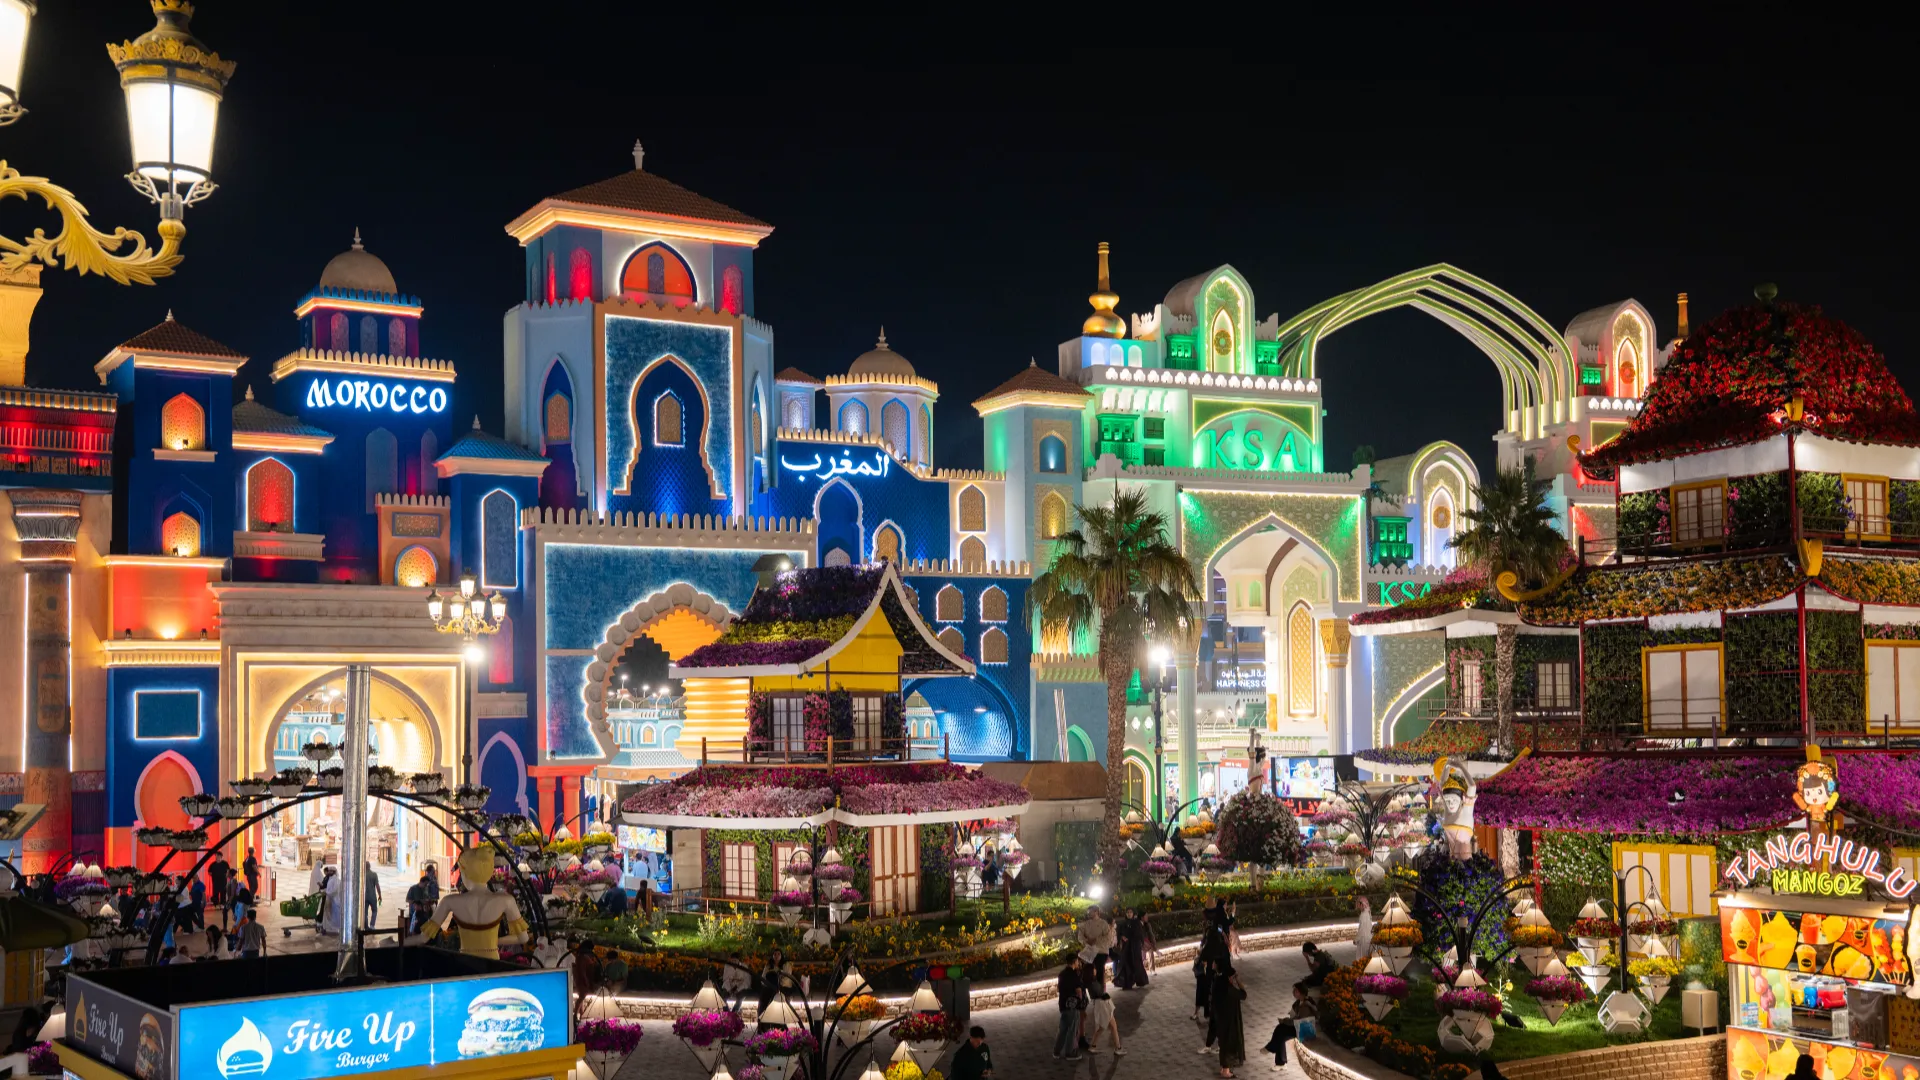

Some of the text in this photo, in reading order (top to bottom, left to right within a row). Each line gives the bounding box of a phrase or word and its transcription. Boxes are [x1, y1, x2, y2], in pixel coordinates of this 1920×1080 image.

[306, 378, 447, 414] MOROCCO
[781, 449, 889, 482] المغرب
[1204, 429, 1309, 471] KSA
[1725, 832, 1917, 898] TANGHULU
[1772, 868, 1865, 896] MANGOZ
[88, 1003, 124, 1055] Fire Up
[283, 1010, 416, 1055] Fire Up
[336, 1051, 390, 1069] Burger
